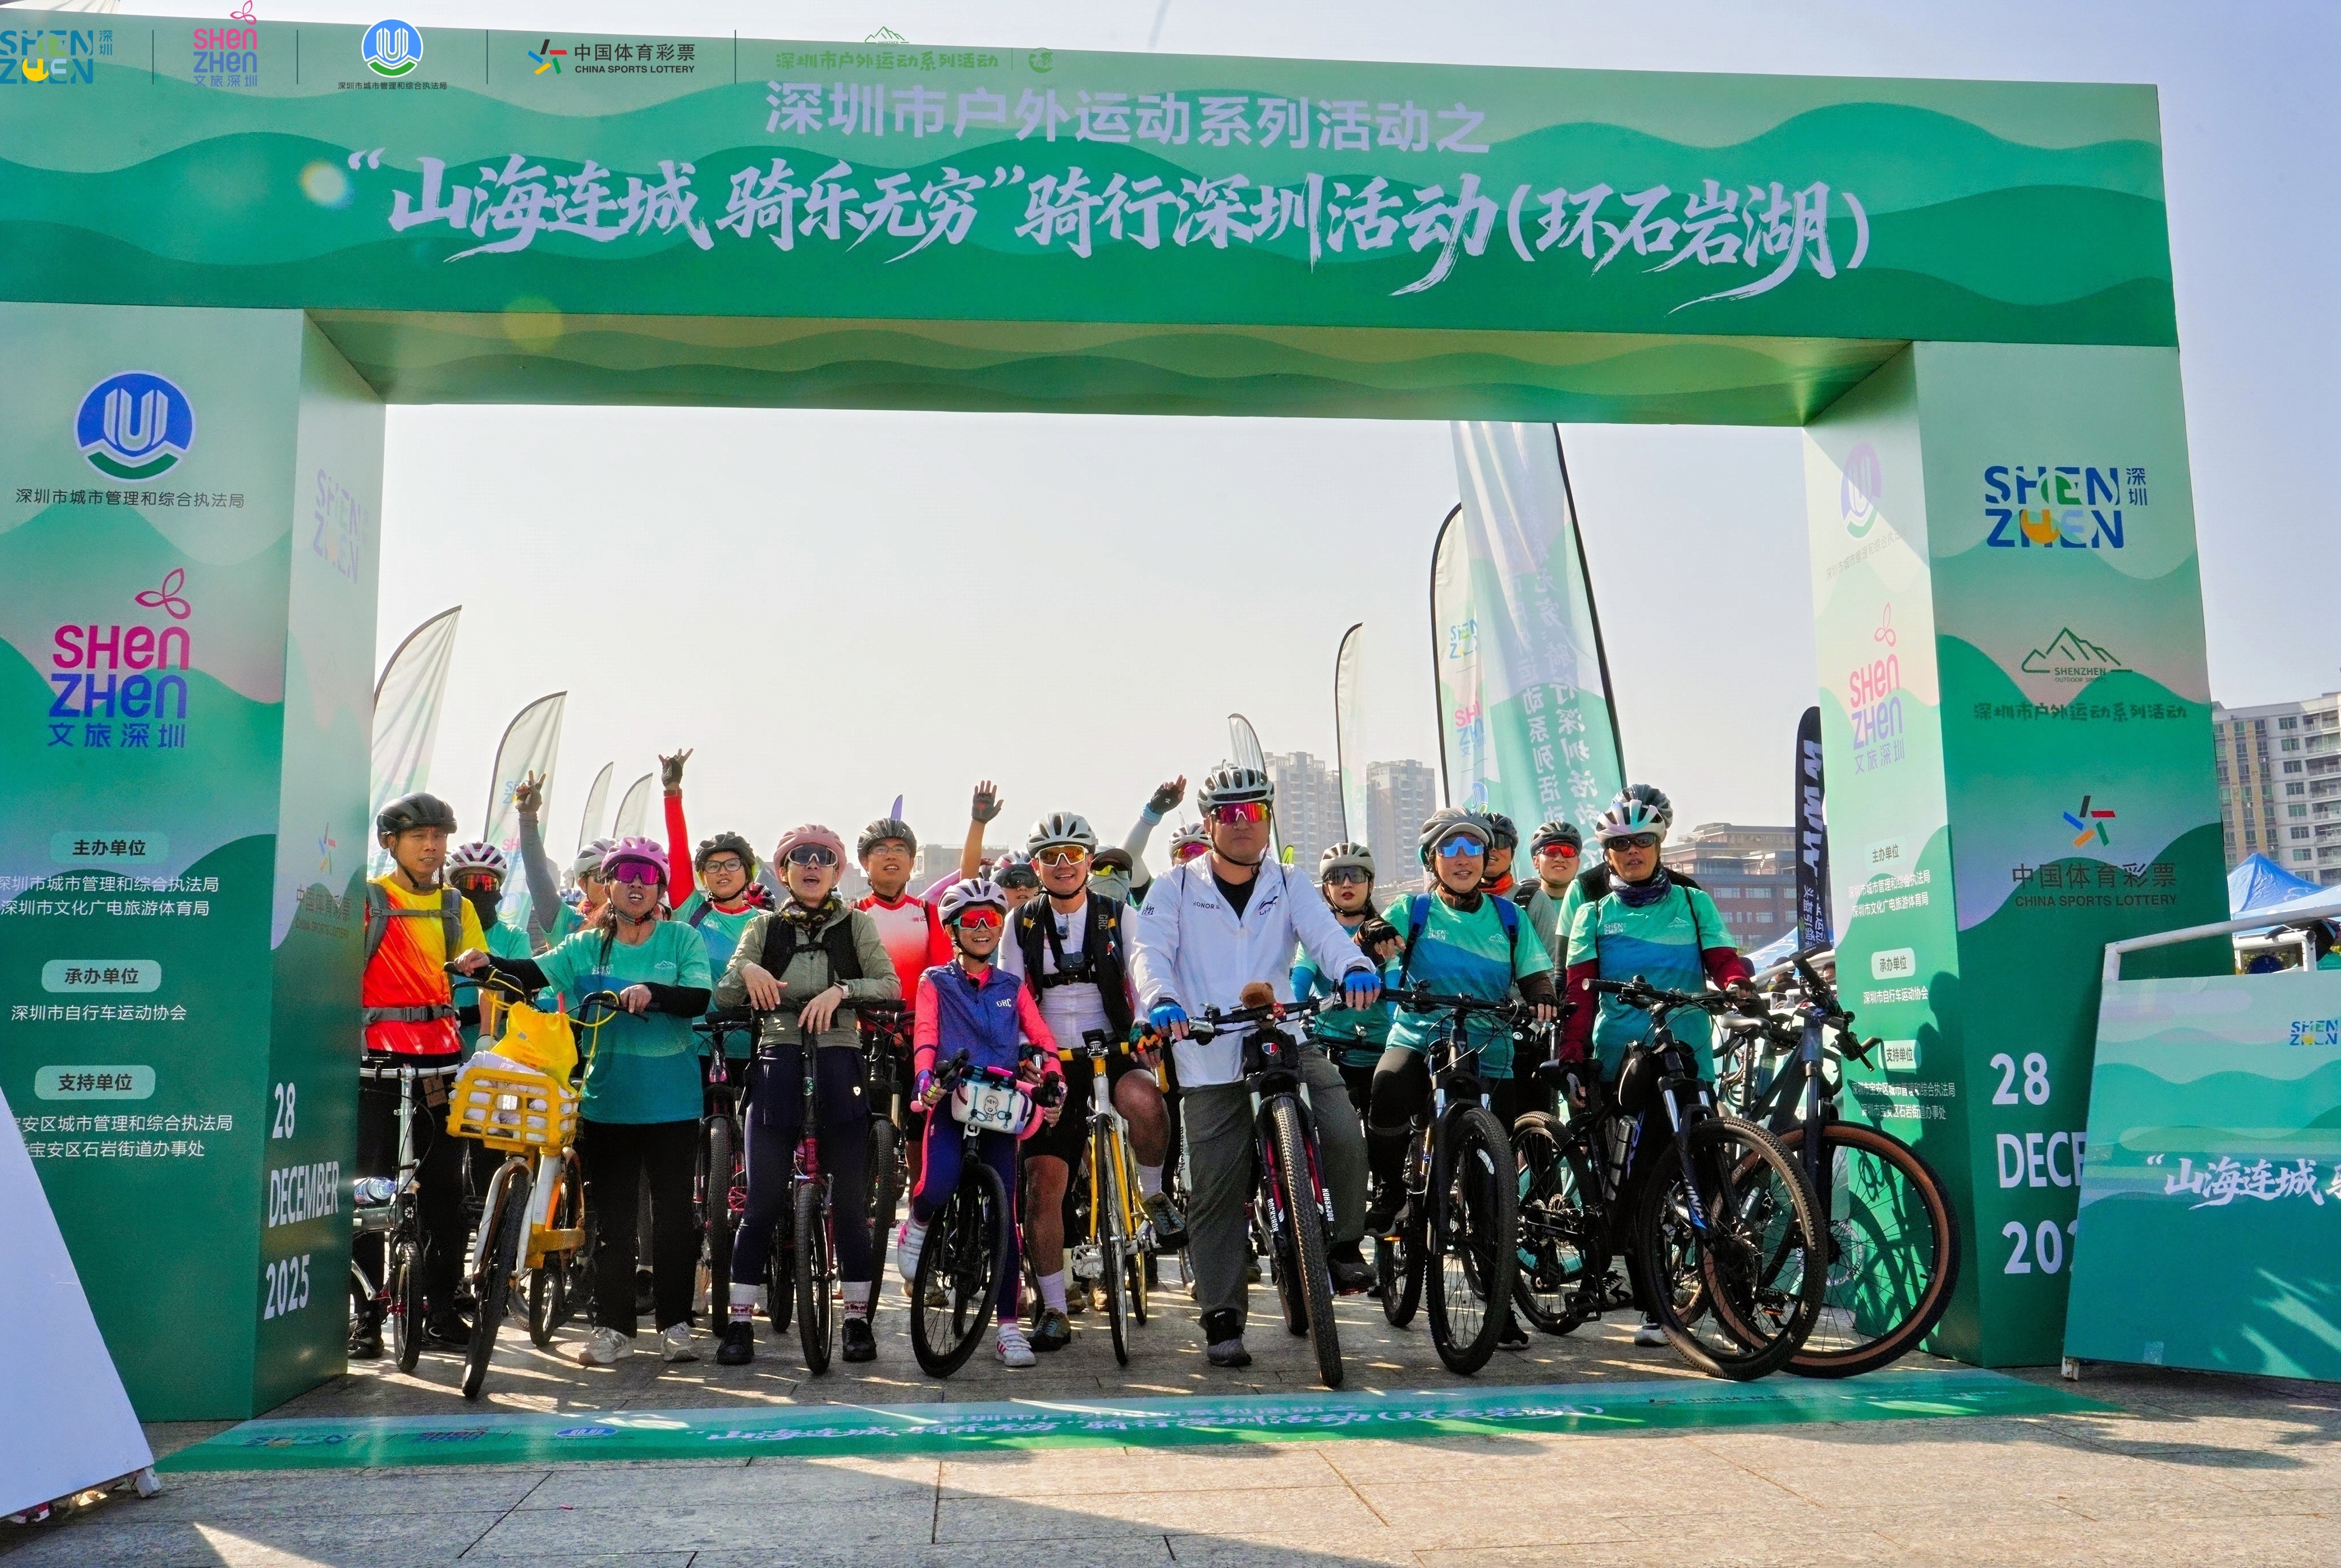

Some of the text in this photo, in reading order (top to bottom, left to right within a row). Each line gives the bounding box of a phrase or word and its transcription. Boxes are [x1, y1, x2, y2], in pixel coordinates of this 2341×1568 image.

[766, 79, 1491, 154] 深圳市户外运动系列活动之
[15, 488, 245, 509] 深圳市城市管理和综合执法局
[1984, 465, 2120, 505] SHEN
[2126, 467, 2148, 506] 深圳
[2055, 667, 2107, 676] SHENZHEN
[1973, 701, 2188, 723] 深圳市户外运动系列活动
[47, 723, 186, 749] 文旅深圳
[1854, 737, 1905, 775] 文旅深圳
[73, 840, 146, 856] 主办单位
[1872, 844, 1899, 863] 主办单位
[1848, 869, 1930, 899] 深圳市城市管理和综合执法局
[2012, 862, 2176, 889] 中国体育彩票
[1, 900, 210, 917] 深圳市文化广电旅游体育局
[1852, 891, 1929, 918] 深圳市文化广电旅游体育局
[2015, 894, 2177, 907] CHINA SPORTS LOTTERY
[65, 968, 139, 985] 承办单位
[1880, 955, 1907, 972] 承办单位
[1863, 986, 1929, 1005] 深圳市自行车运动协会
[11, 1005, 187, 1022] 深圳市自行车运动协会
[1886, 1047, 1913, 1062] 支持单位
[58, 1074, 132, 1091] 支持单位
[1990, 1052, 2051, 1106] 28
[272, 1083, 296, 1139] 28
[1996, 1132, 2087, 1188] DECE
[269, 1161, 339, 1228] DECEMBER
[1322, 1188, 1335, 1222] ROCKSHOX
[1267, 1198, 1279, 1232] ROCKSHOX
[2002, 1220, 2078, 1274] 20
[264, 1254, 310, 1320] 2025
